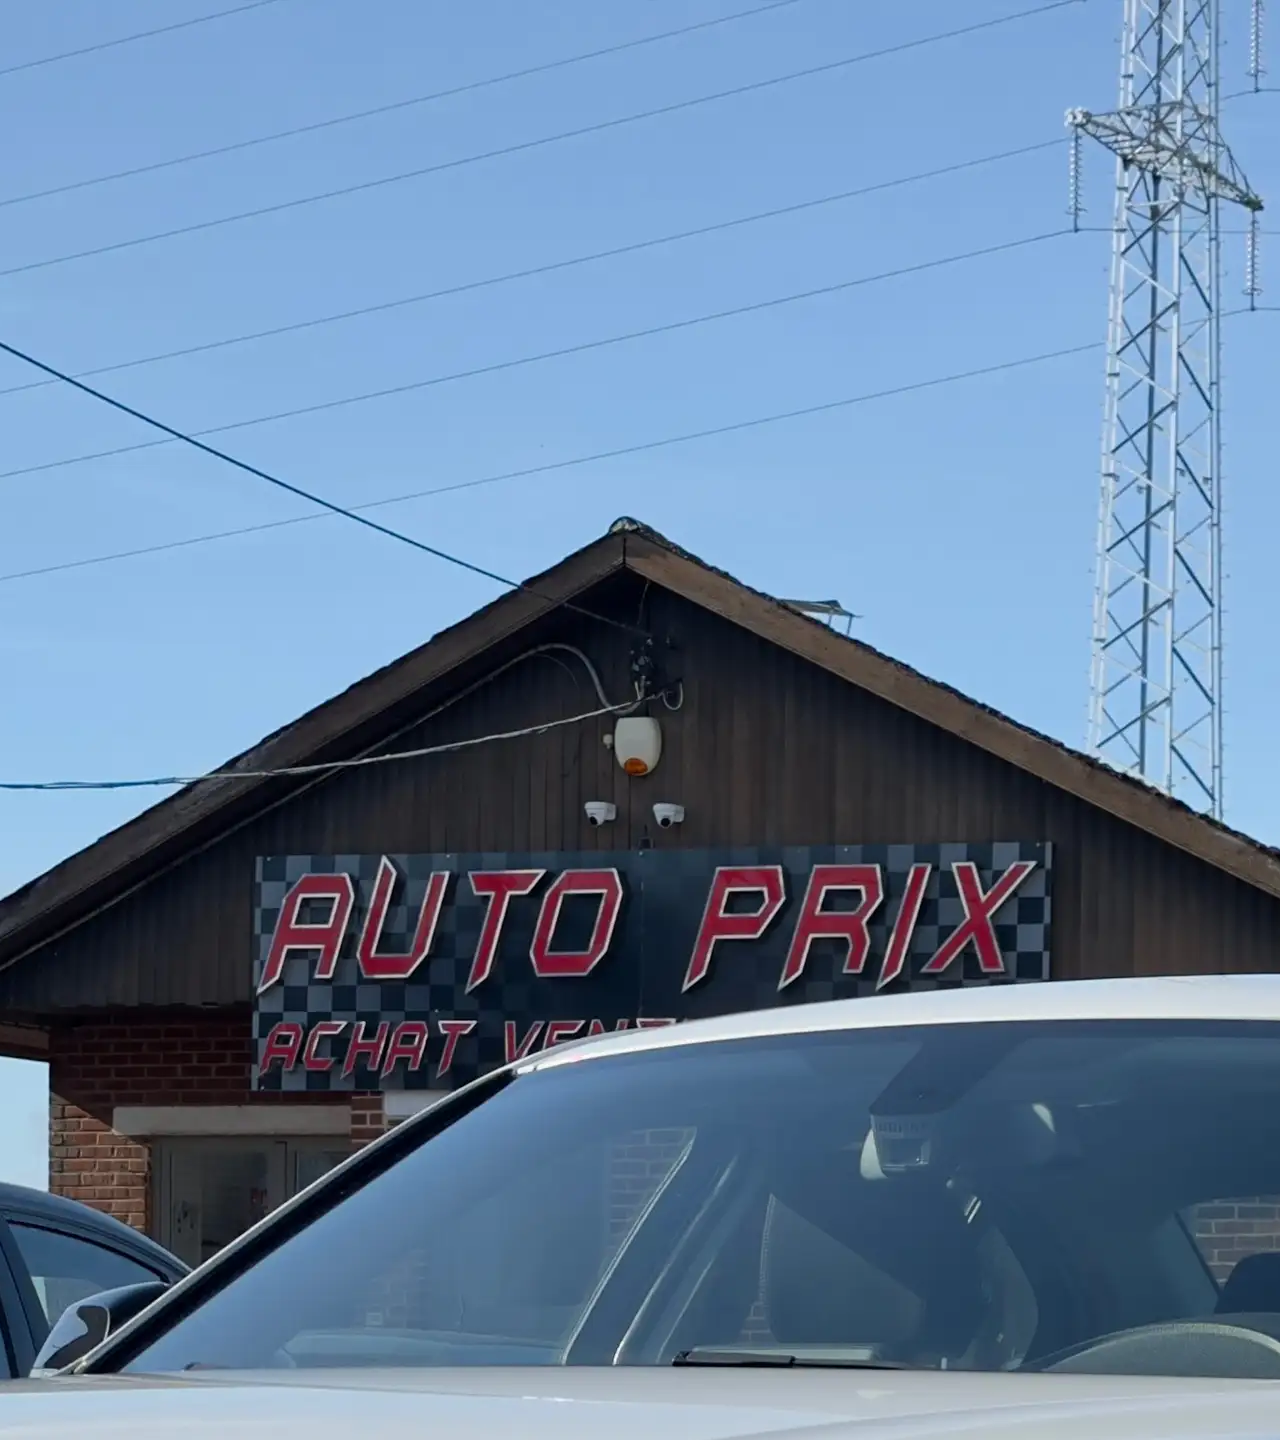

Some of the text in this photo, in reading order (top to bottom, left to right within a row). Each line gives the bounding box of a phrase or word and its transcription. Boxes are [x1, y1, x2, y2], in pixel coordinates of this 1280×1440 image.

[257, 856, 1037, 995] AUTO PRIX
[259, 1020, 478, 1079] ACHAT
